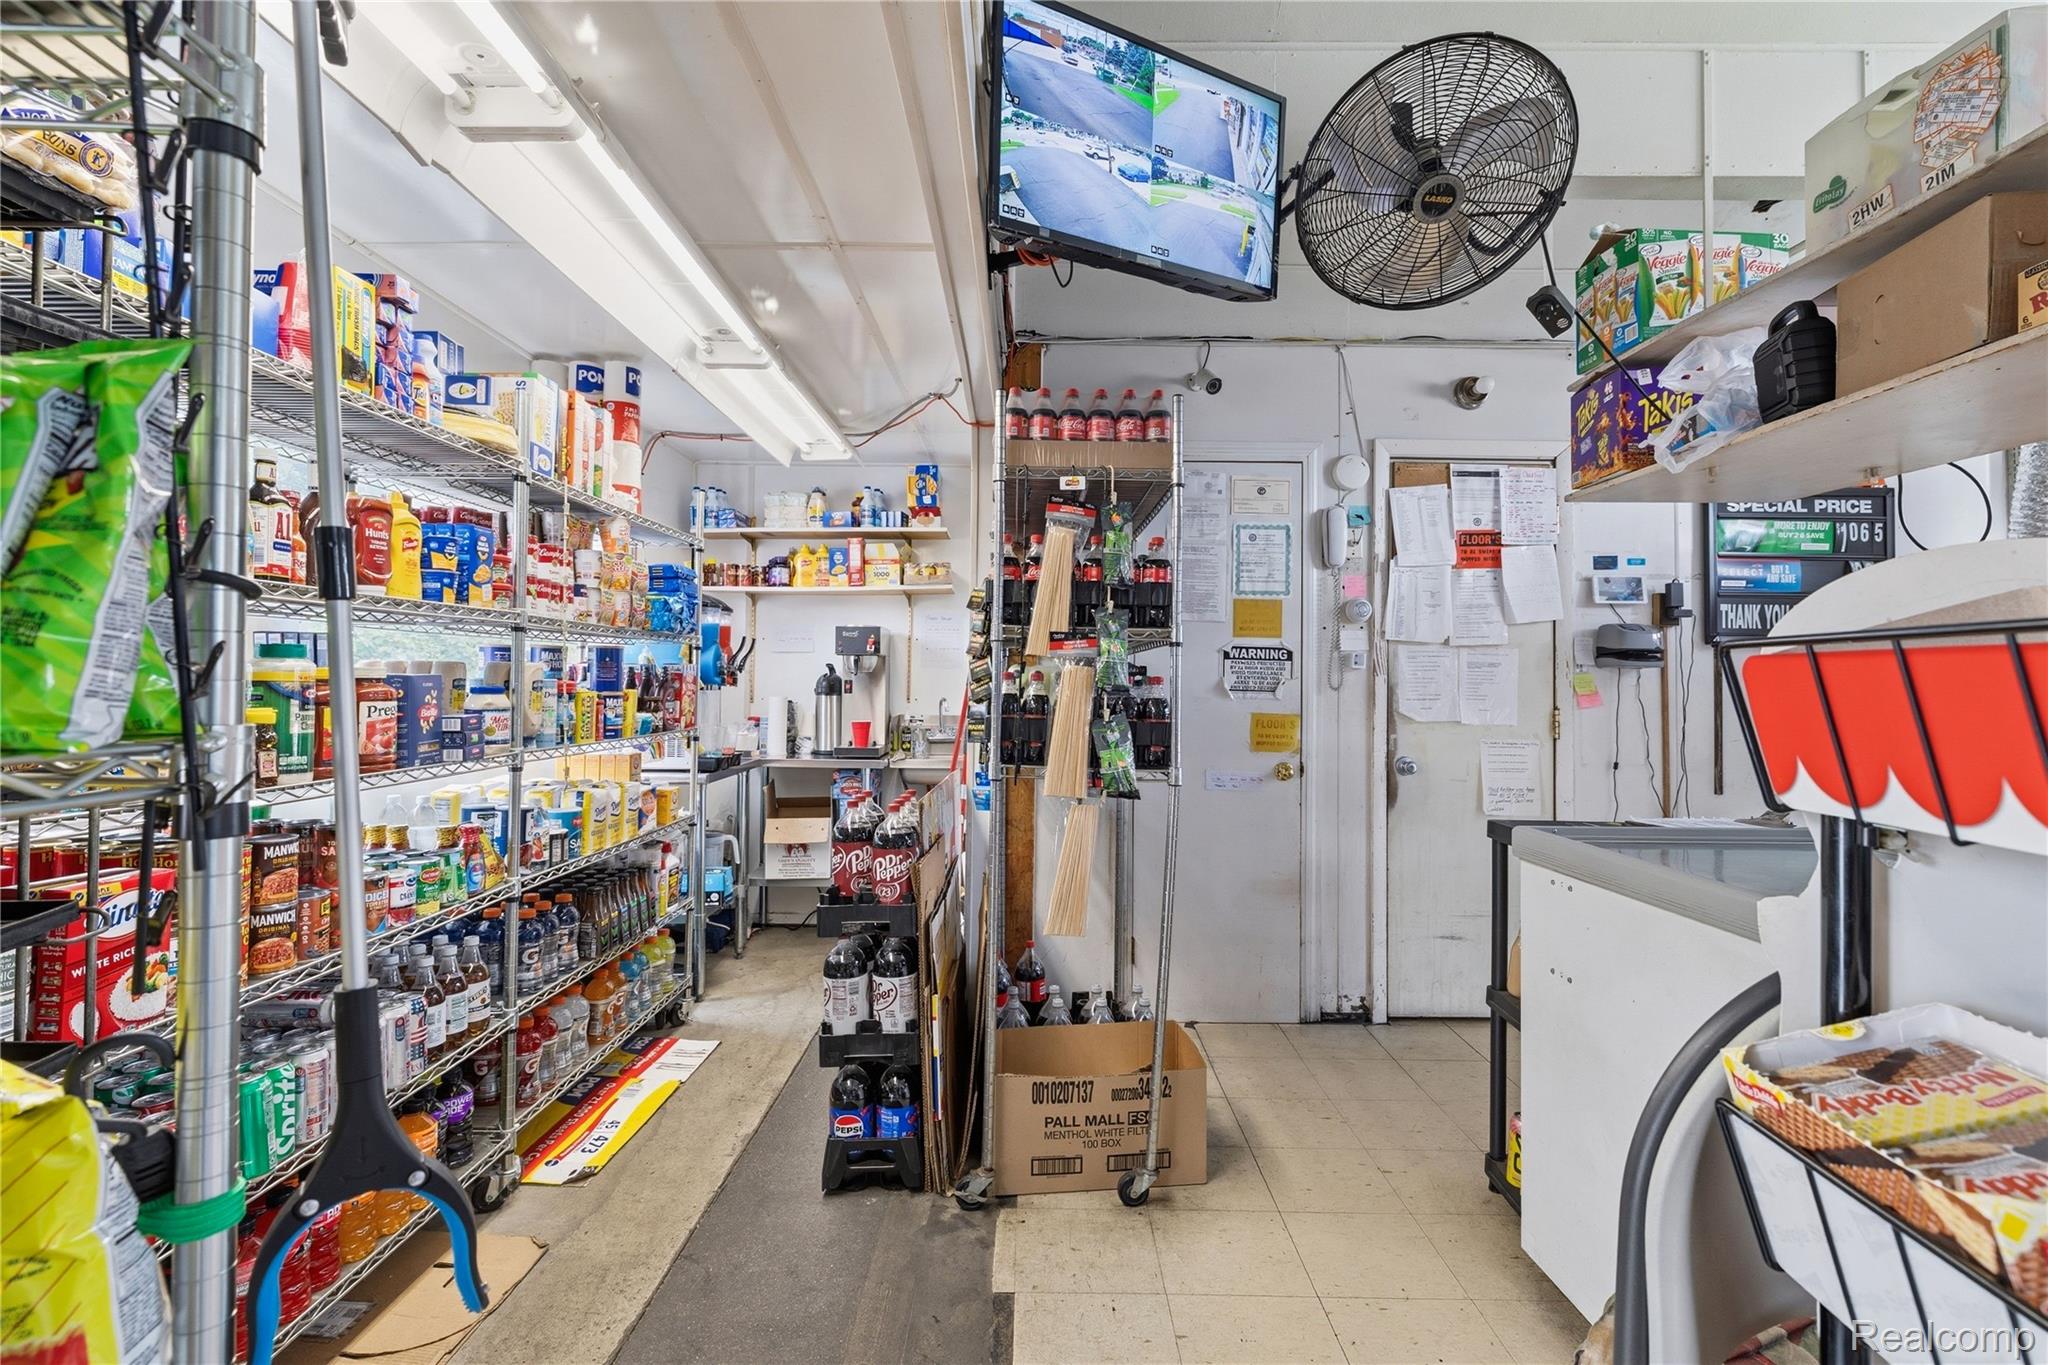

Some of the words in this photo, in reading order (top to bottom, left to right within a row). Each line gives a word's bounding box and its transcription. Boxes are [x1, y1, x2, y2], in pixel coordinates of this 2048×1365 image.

[1925, 163, 1956, 191] 2IM
[1424, 194, 1454, 204] LASKO
[1852, 193, 1884, 226] 2HW
[1773, 233, 1790, 244] 30
[1647, 250, 1687, 271] Veggie
[628, 372, 641, 387] PO
[1726, 499, 1808, 513] SPECIAL
[1814, 499, 1873, 514] PRICE
[275, 511, 292, 540] A1
[1807, 521, 1831, 531] ENJOY
[1461, 534, 1501, 545] FLOOR'S
[1720, 603, 1762, 630] THANK
[1230, 647, 1288, 660] WARNING
[367, 704, 397, 718] Preg
[264, 840, 299, 860] MANWI
[874, 857, 912, 882] Pepper
[884, 854, 903, 868] Dr
[881, 887, 891, 896] 23
[250, 908, 297, 929] MANWICH
[521, 947, 541, 965] G
[71, 959, 110, 979] WTE
[872, 989, 894, 1004] pper
[567, 1076, 600, 1097] POM
[1910, 1066, 2019, 1096] Nutty
[1031, 1080, 1094, 1105] 0010207137
[1816, 1085, 1922, 1119] Buddy
[275, 1062, 296, 1155] Sprite
[835, 1125, 863, 1134] PEPSI
[1044, 1116, 1081, 1129] PALL
[1084, 1113, 1125, 1127] MALL
[1043, 1129, 1092, 1141] MENTHOL
[1095, 1127, 1125, 1138] WHITE
[1127, 1126, 1150, 1137] FILT
[581, 1134, 609, 1154] 473
[1082, 1139, 1098, 1150] 100
[1101, 1138, 1122, 1149] BOX
[1963, 1170, 2048, 1201] uddy
